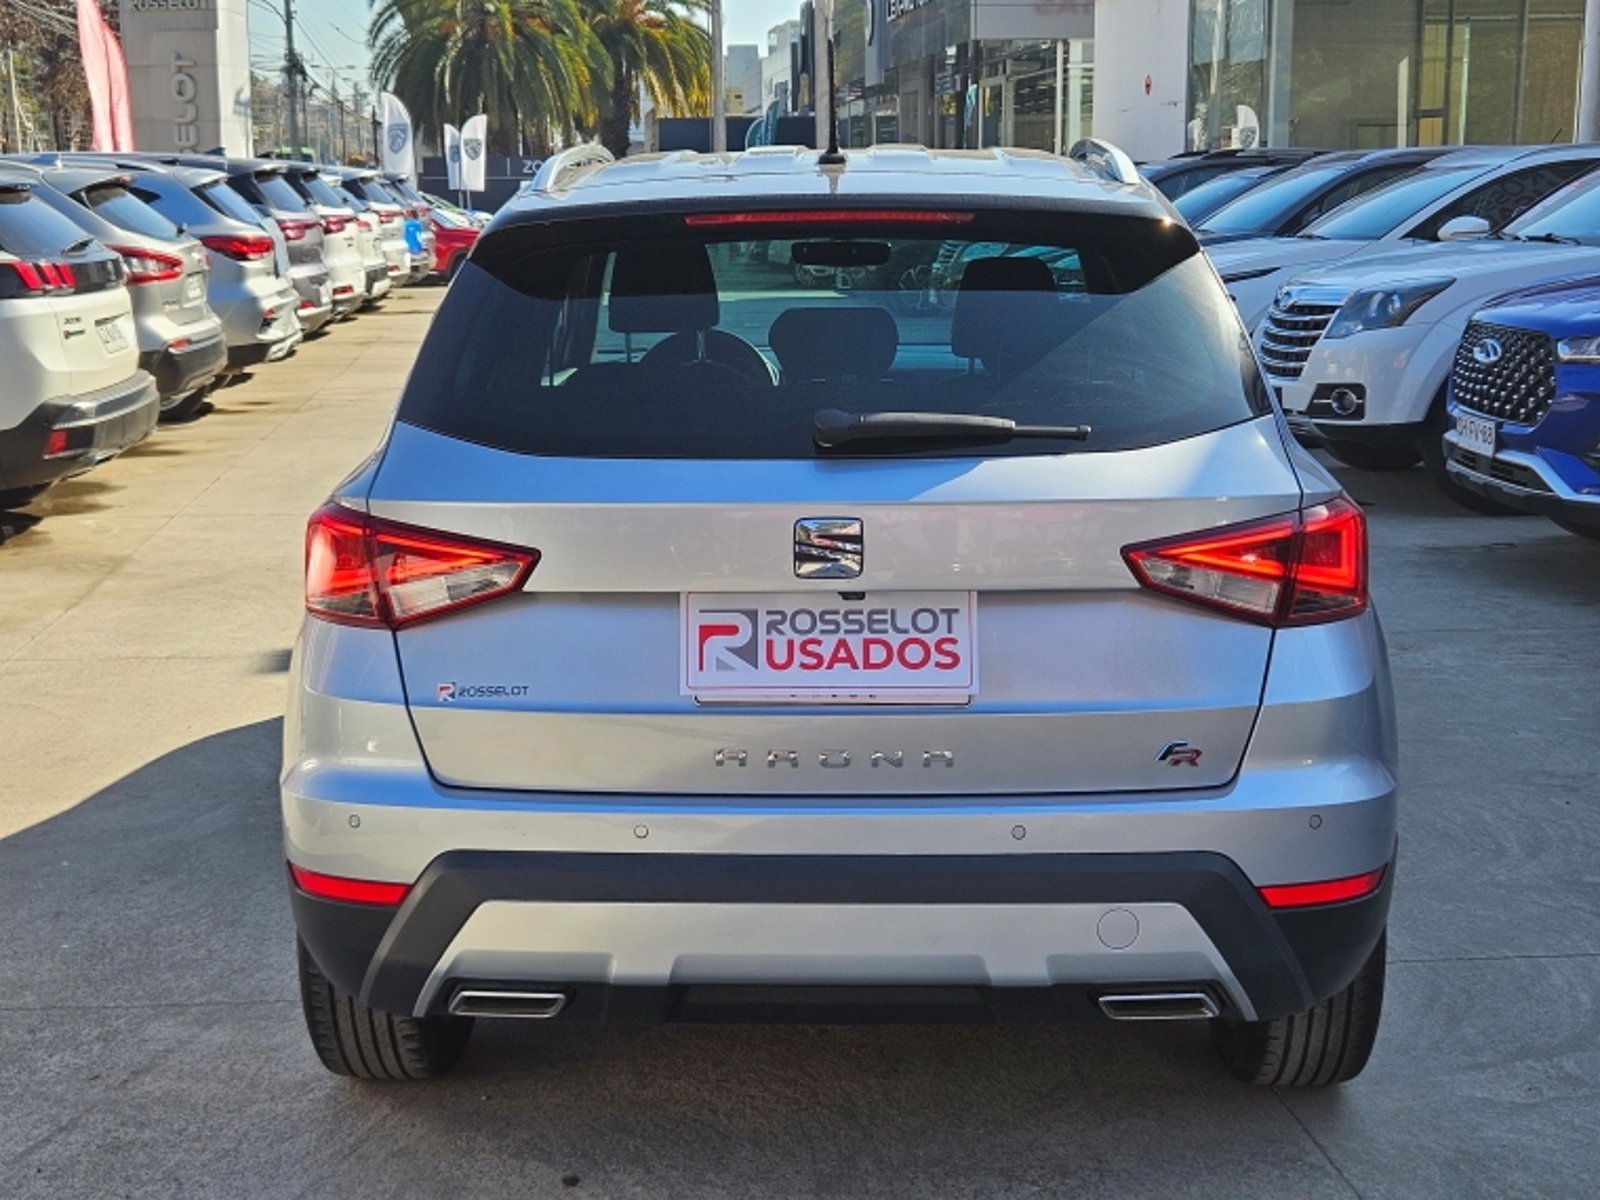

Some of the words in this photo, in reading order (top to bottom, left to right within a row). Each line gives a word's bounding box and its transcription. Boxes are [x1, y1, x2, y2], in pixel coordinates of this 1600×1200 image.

[170, 52, 198, 153] ELOT
[766, 608, 960, 635] ROSSELOT
[765, 637, 961, 671] USADOS
[459, 685, 529, 697] ROSSELOT
[714, 749, 954, 769] ARONA
[1154, 740, 1202, 767] FR
